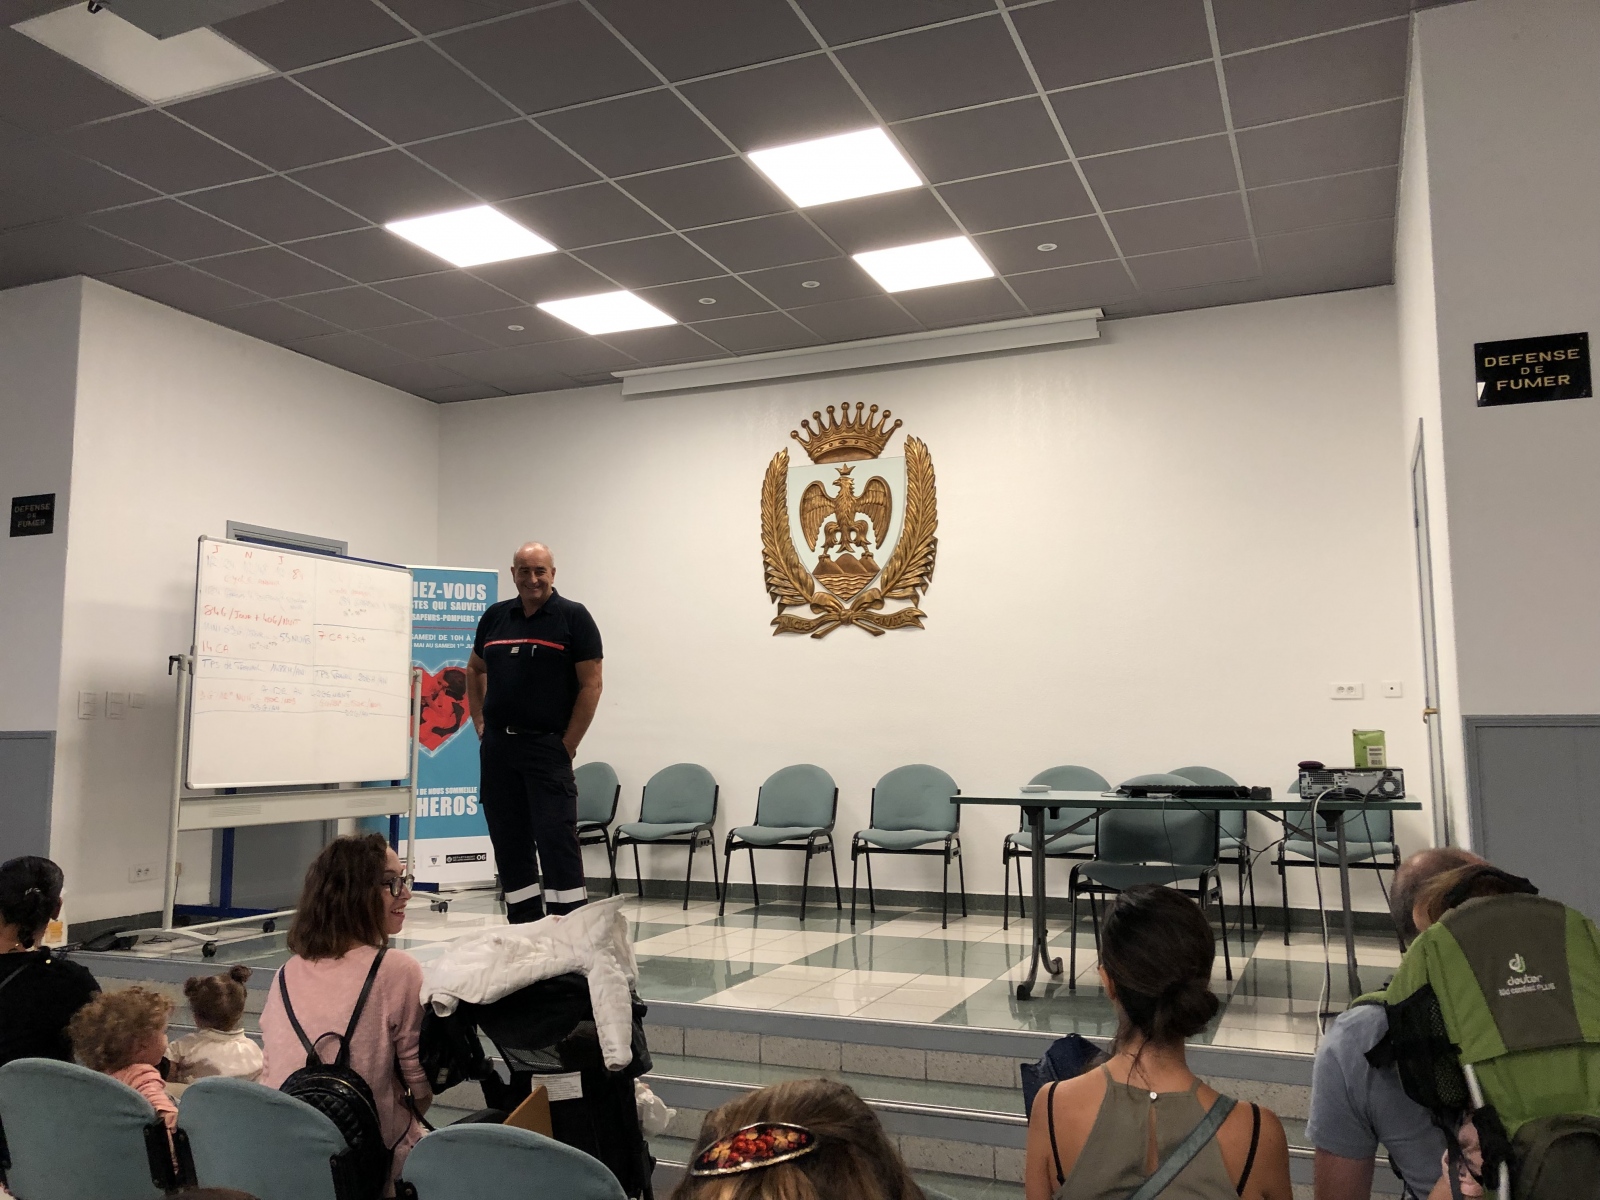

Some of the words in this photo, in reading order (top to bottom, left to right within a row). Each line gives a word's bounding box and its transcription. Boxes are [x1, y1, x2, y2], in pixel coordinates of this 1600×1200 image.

[1484, 348, 1581, 368] DEFENSE
[1520, 365, 1545, 375] DE
[1496, 374, 1571, 391] FUMER
[14, 503, 51, 513] DEFENSE
[17, 518, 46, 528] FUMER
[413, 581, 487, 601] IEZ-VOUS
[432, 600, 447, 611] QUI
[450, 601, 487, 612] SAUVENT
[412, 613, 475, 623] SAPEURS-POMPIERS
[428, 787, 444, 795] NOUS
[445, 786, 478, 795] SOMMEILLE
[416, 795, 478, 817] HEROS
